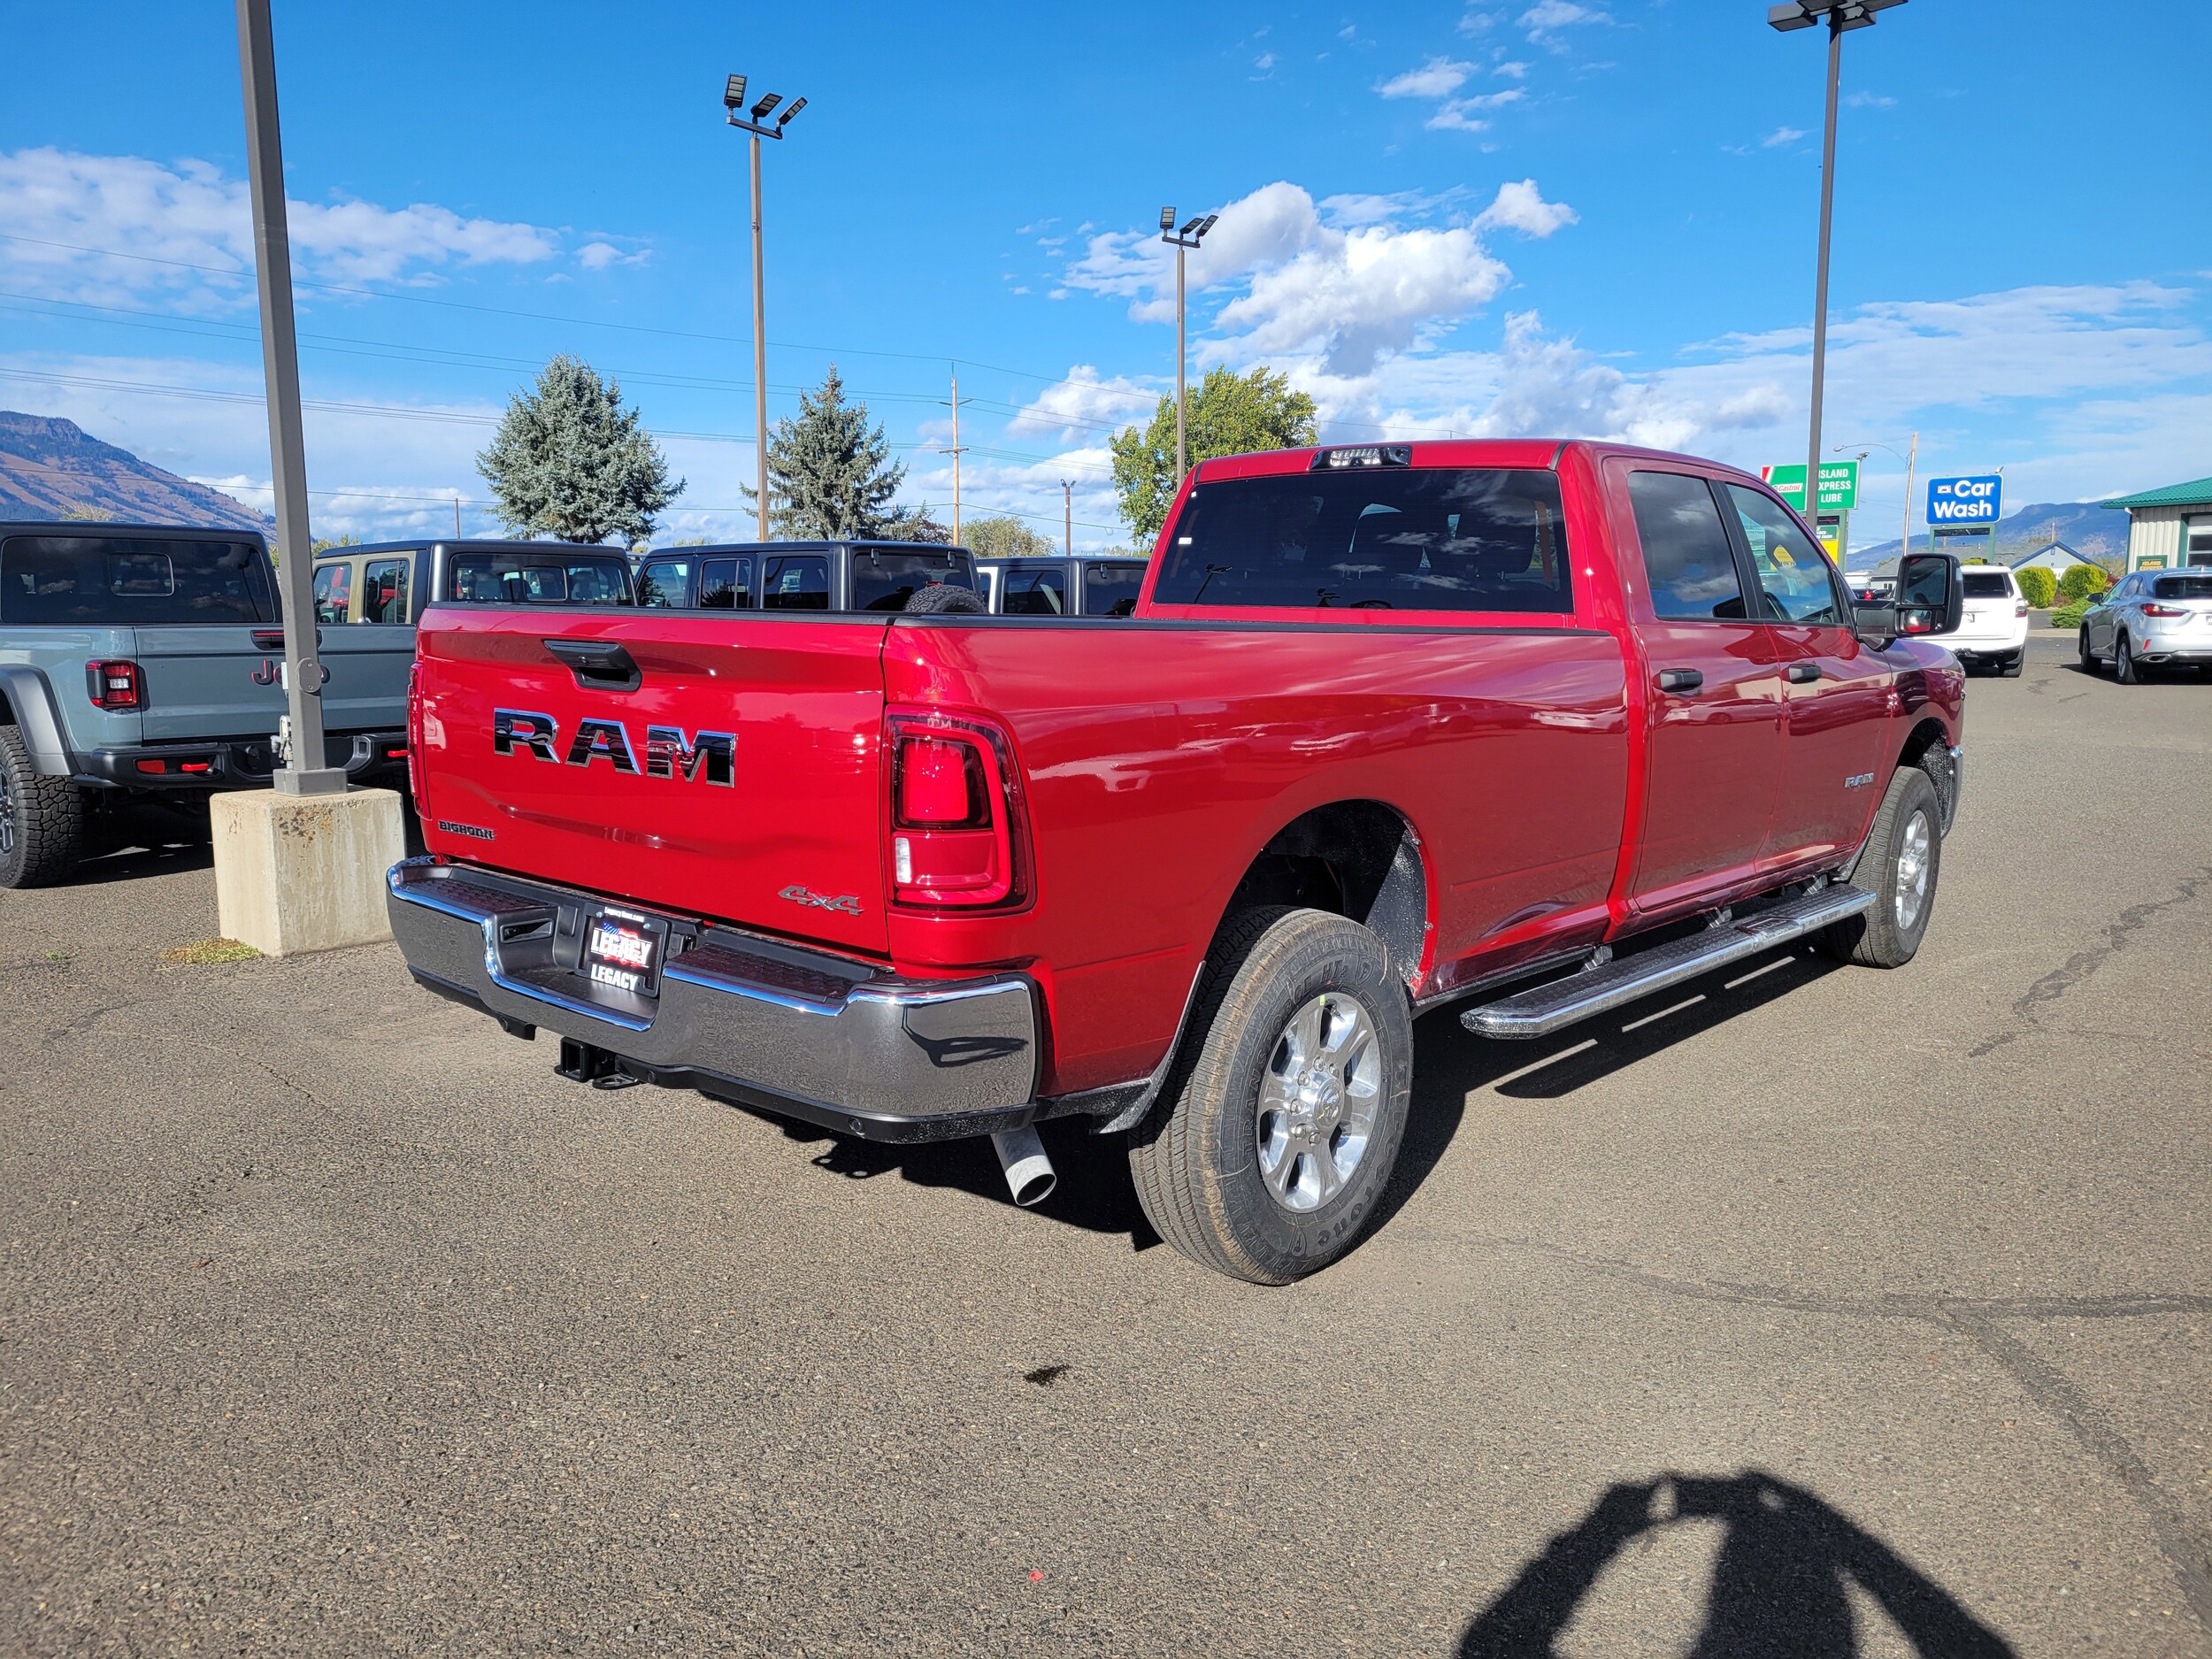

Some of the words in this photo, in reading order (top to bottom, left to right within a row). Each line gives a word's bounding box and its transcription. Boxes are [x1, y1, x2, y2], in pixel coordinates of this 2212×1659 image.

[1816, 480, 1851, 491] XPRESS
[1955, 480, 1994, 497] Car
[1820, 494, 1842, 503] LUBE
[1933, 499, 1993, 518] Wash
[494, 708, 738, 788] RAM
[1844, 772, 1875, 788] RAM
[438, 819, 495, 841] BIGHORN
[590, 929, 652, 965] LEGACY
[590, 964, 639, 991] LEGACY
[1320, 959, 1349, 985] HT2
